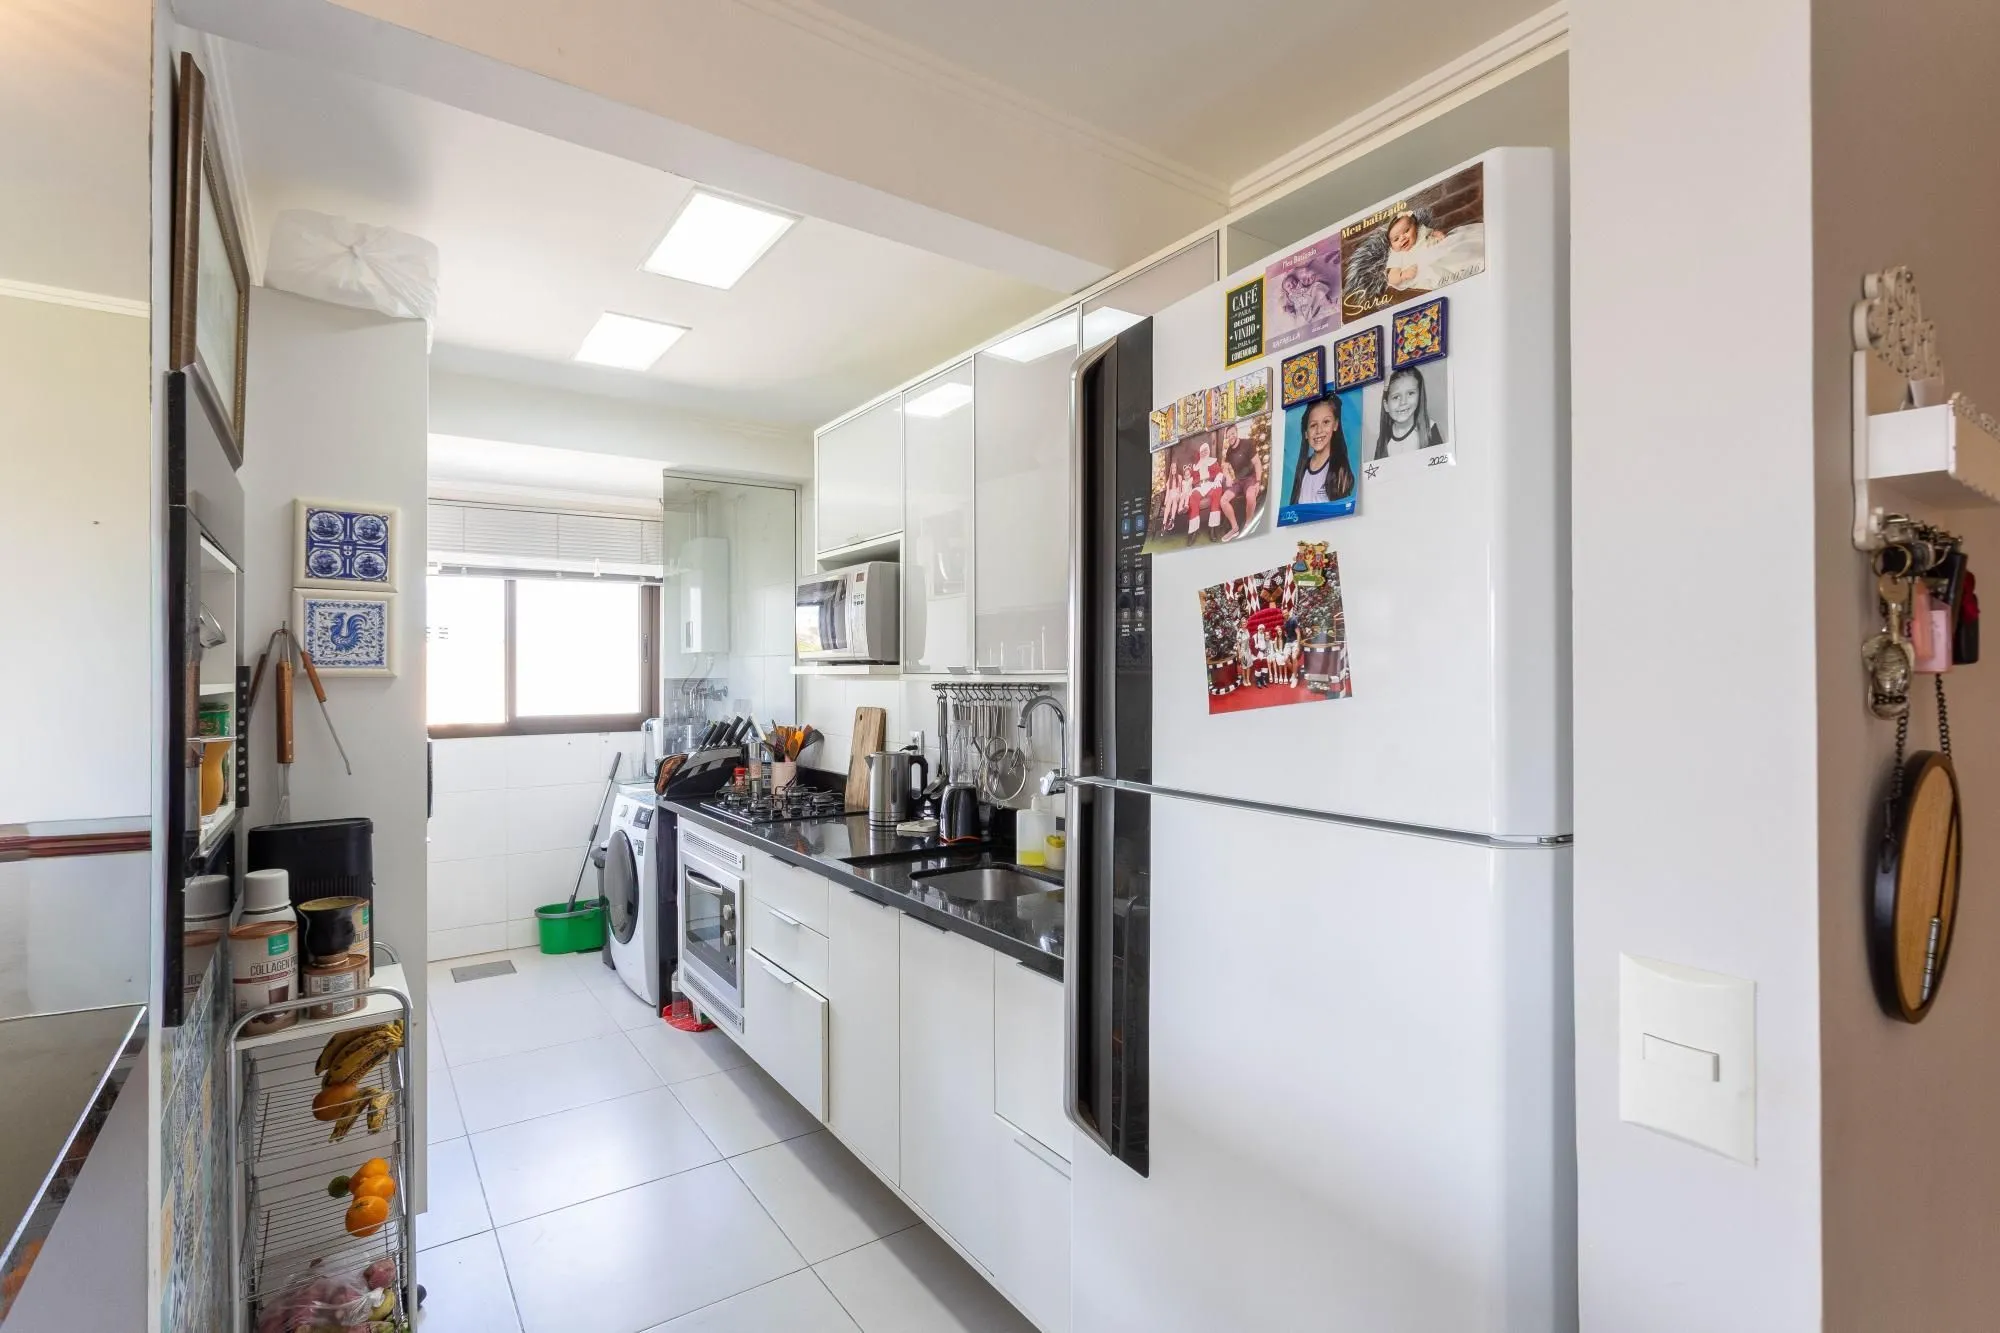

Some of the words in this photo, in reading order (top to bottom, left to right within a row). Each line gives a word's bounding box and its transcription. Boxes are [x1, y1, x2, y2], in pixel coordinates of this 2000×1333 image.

[1363, 201, 1407, 228] batizado
[1232, 284, 1258, 312] CAFÉ
[1343, 289, 1393, 316] Sara
[1233, 314, 1256, 329] DECIDIR
[1234, 323, 1256, 342] VINHO
[250, 959, 290, 977] COLLAGEN
